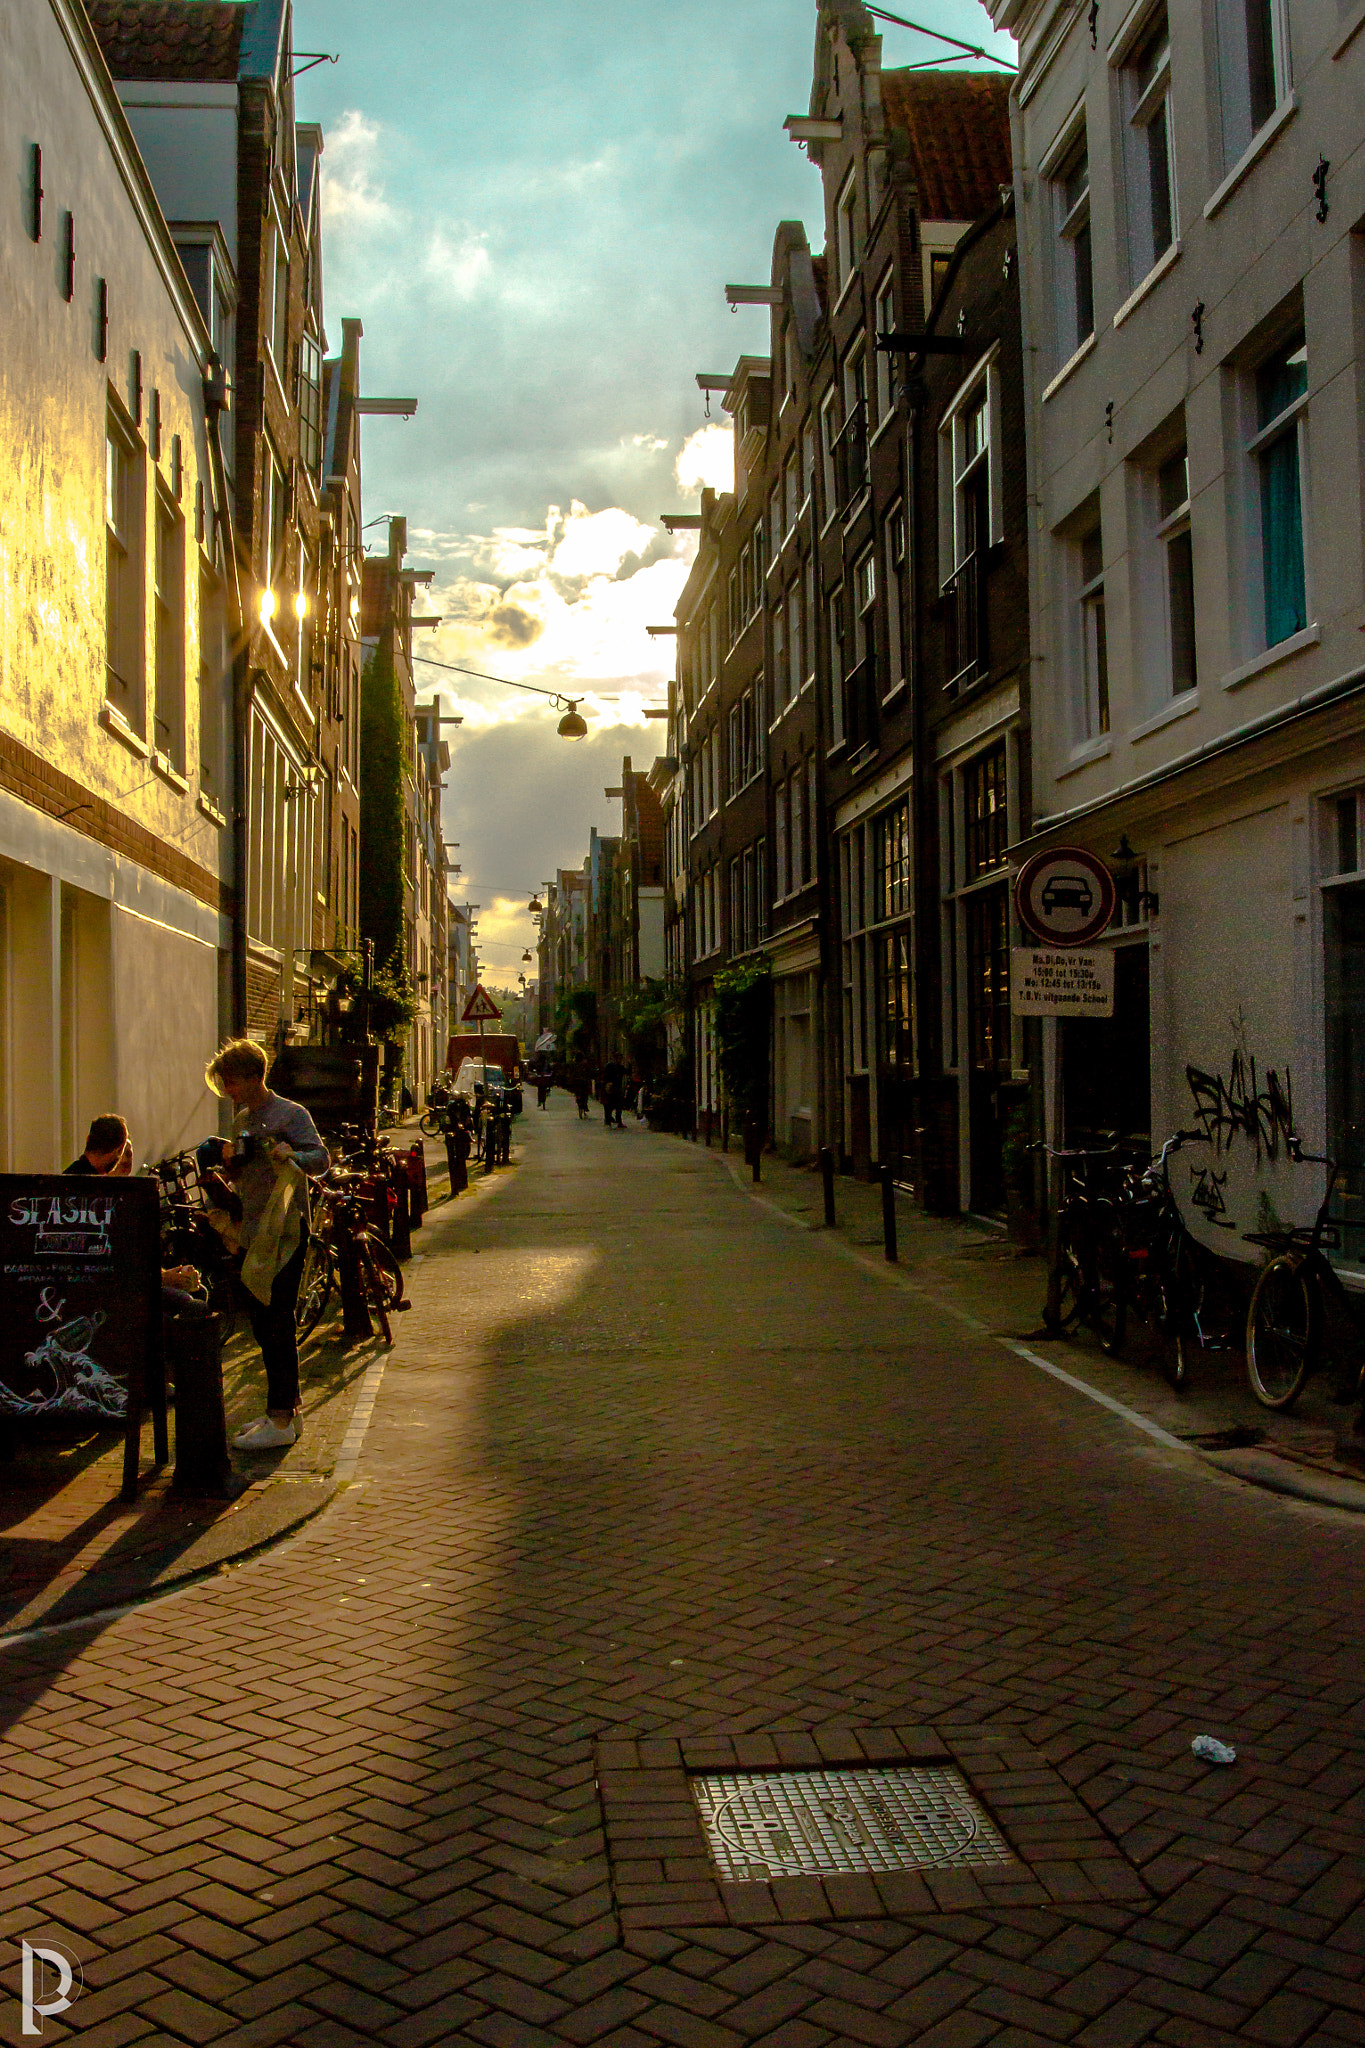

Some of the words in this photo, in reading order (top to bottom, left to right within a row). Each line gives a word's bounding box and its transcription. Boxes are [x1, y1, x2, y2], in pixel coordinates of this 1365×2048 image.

[1033, 967, 1054, 977] 15:00
[1055, 968, 1067, 978] tot
[1040, 977, 1061, 988] 12:45
[1062, 979, 1074, 989] tot
[1043, 993, 1080, 1005] uitgaande
[1082, 993, 1108, 1004] School
[35, 1286, 67, 1323] &
